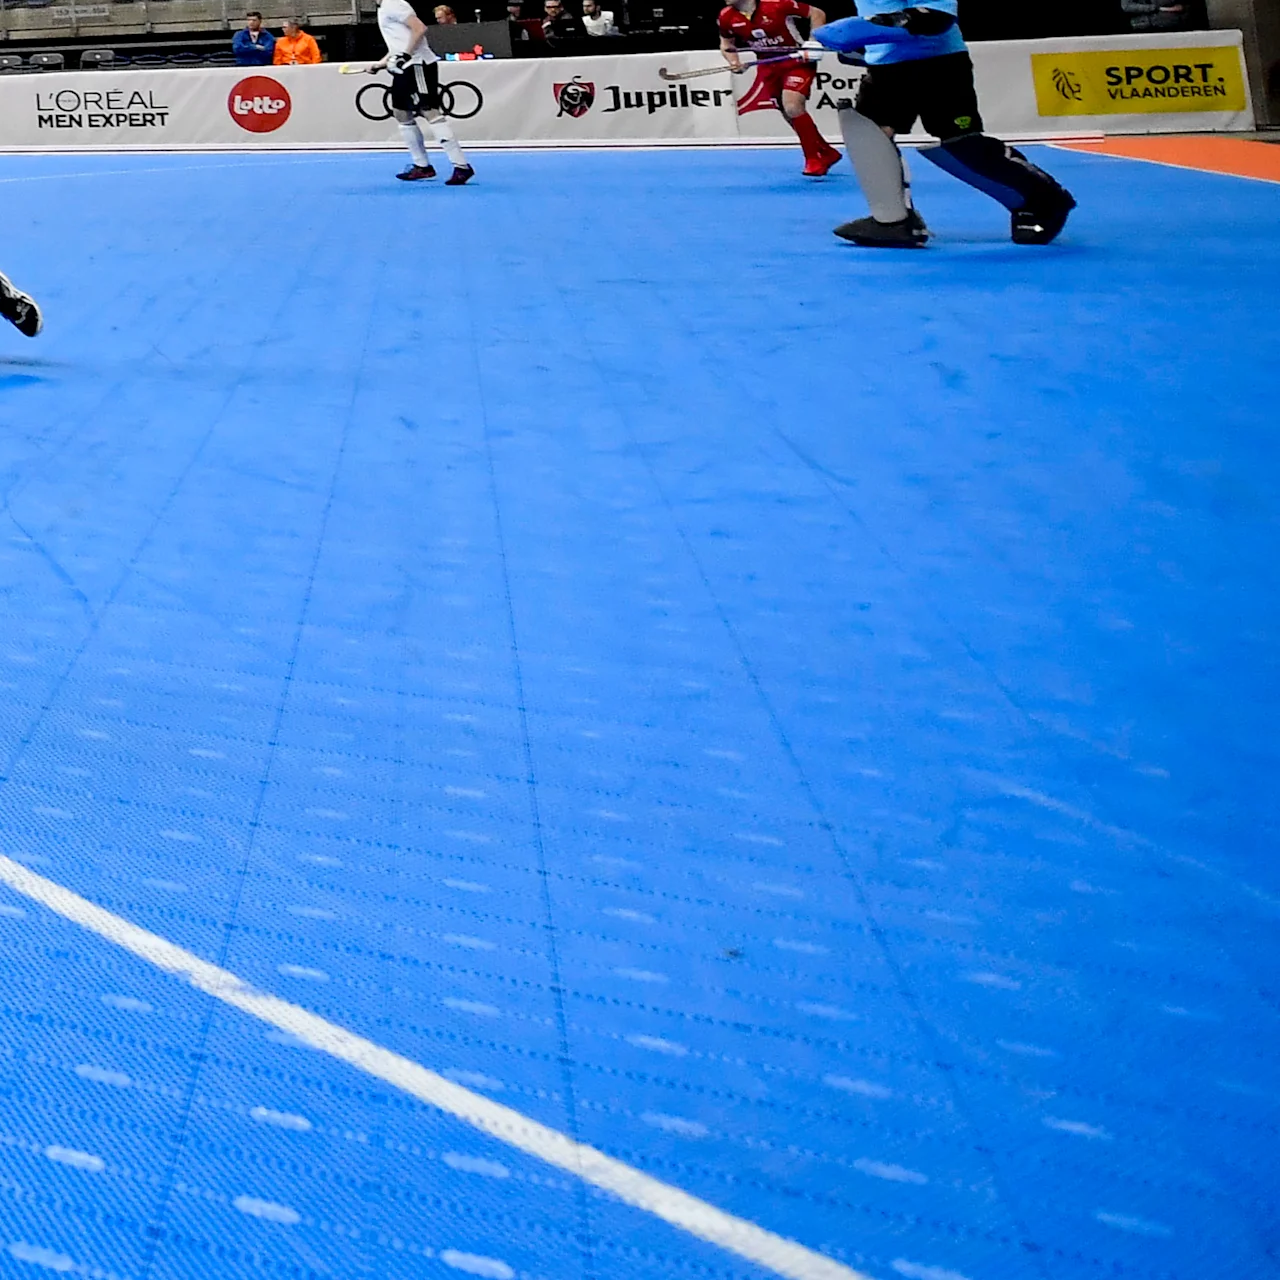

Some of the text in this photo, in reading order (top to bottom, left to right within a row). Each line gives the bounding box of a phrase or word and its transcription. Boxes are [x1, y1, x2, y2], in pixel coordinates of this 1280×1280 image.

[1105, 63, 1225, 86] SPORT.
[37, 88, 169, 111] L'ORÉAL
[601, 84, 733, 115] Jupiler
[1107, 83, 1226, 100] VLAANDEREN
[38, 112, 169, 129] MEN EXPERT
